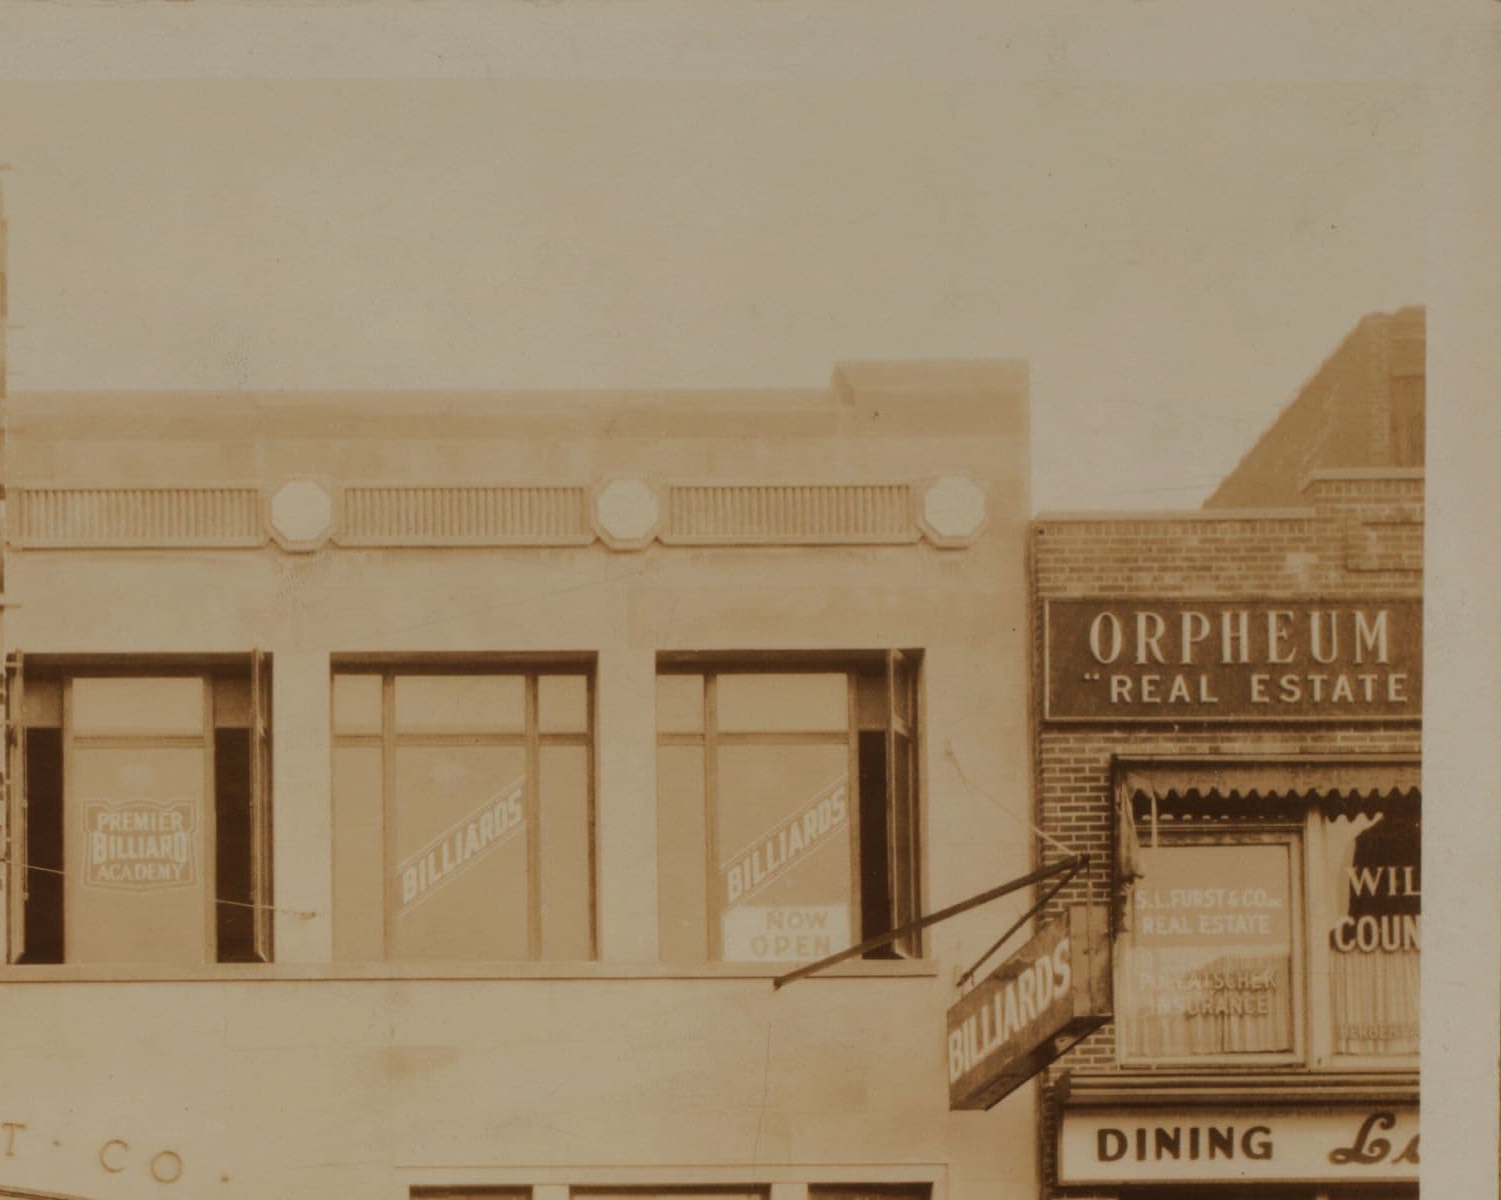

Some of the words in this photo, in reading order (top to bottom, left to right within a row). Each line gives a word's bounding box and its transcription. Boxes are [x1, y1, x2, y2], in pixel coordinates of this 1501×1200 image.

[1089, 609, 1390, 665] ORPHEUM
[1251, 673, 1408, 703] ESTATE
[97, 811, 183, 832] PREMIER
[93, 831, 187, 864] BILLIARD
[403, 788, 522, 904] BILLIARDS
[727, 785, 845, 903] BILLIARDS
[98, 862, 182, 881] ACADEMY
[767, 911, 828, 929] NOW
[1141, 915, 1192, 936] REAL
[1199, 914, 1272, 936] ESTATE
[750, 935, 831, 958] OPEN
[948, 938, 1070, 1084] BILLIARDS
[1097, 1125, 1273, 1163] DINING
